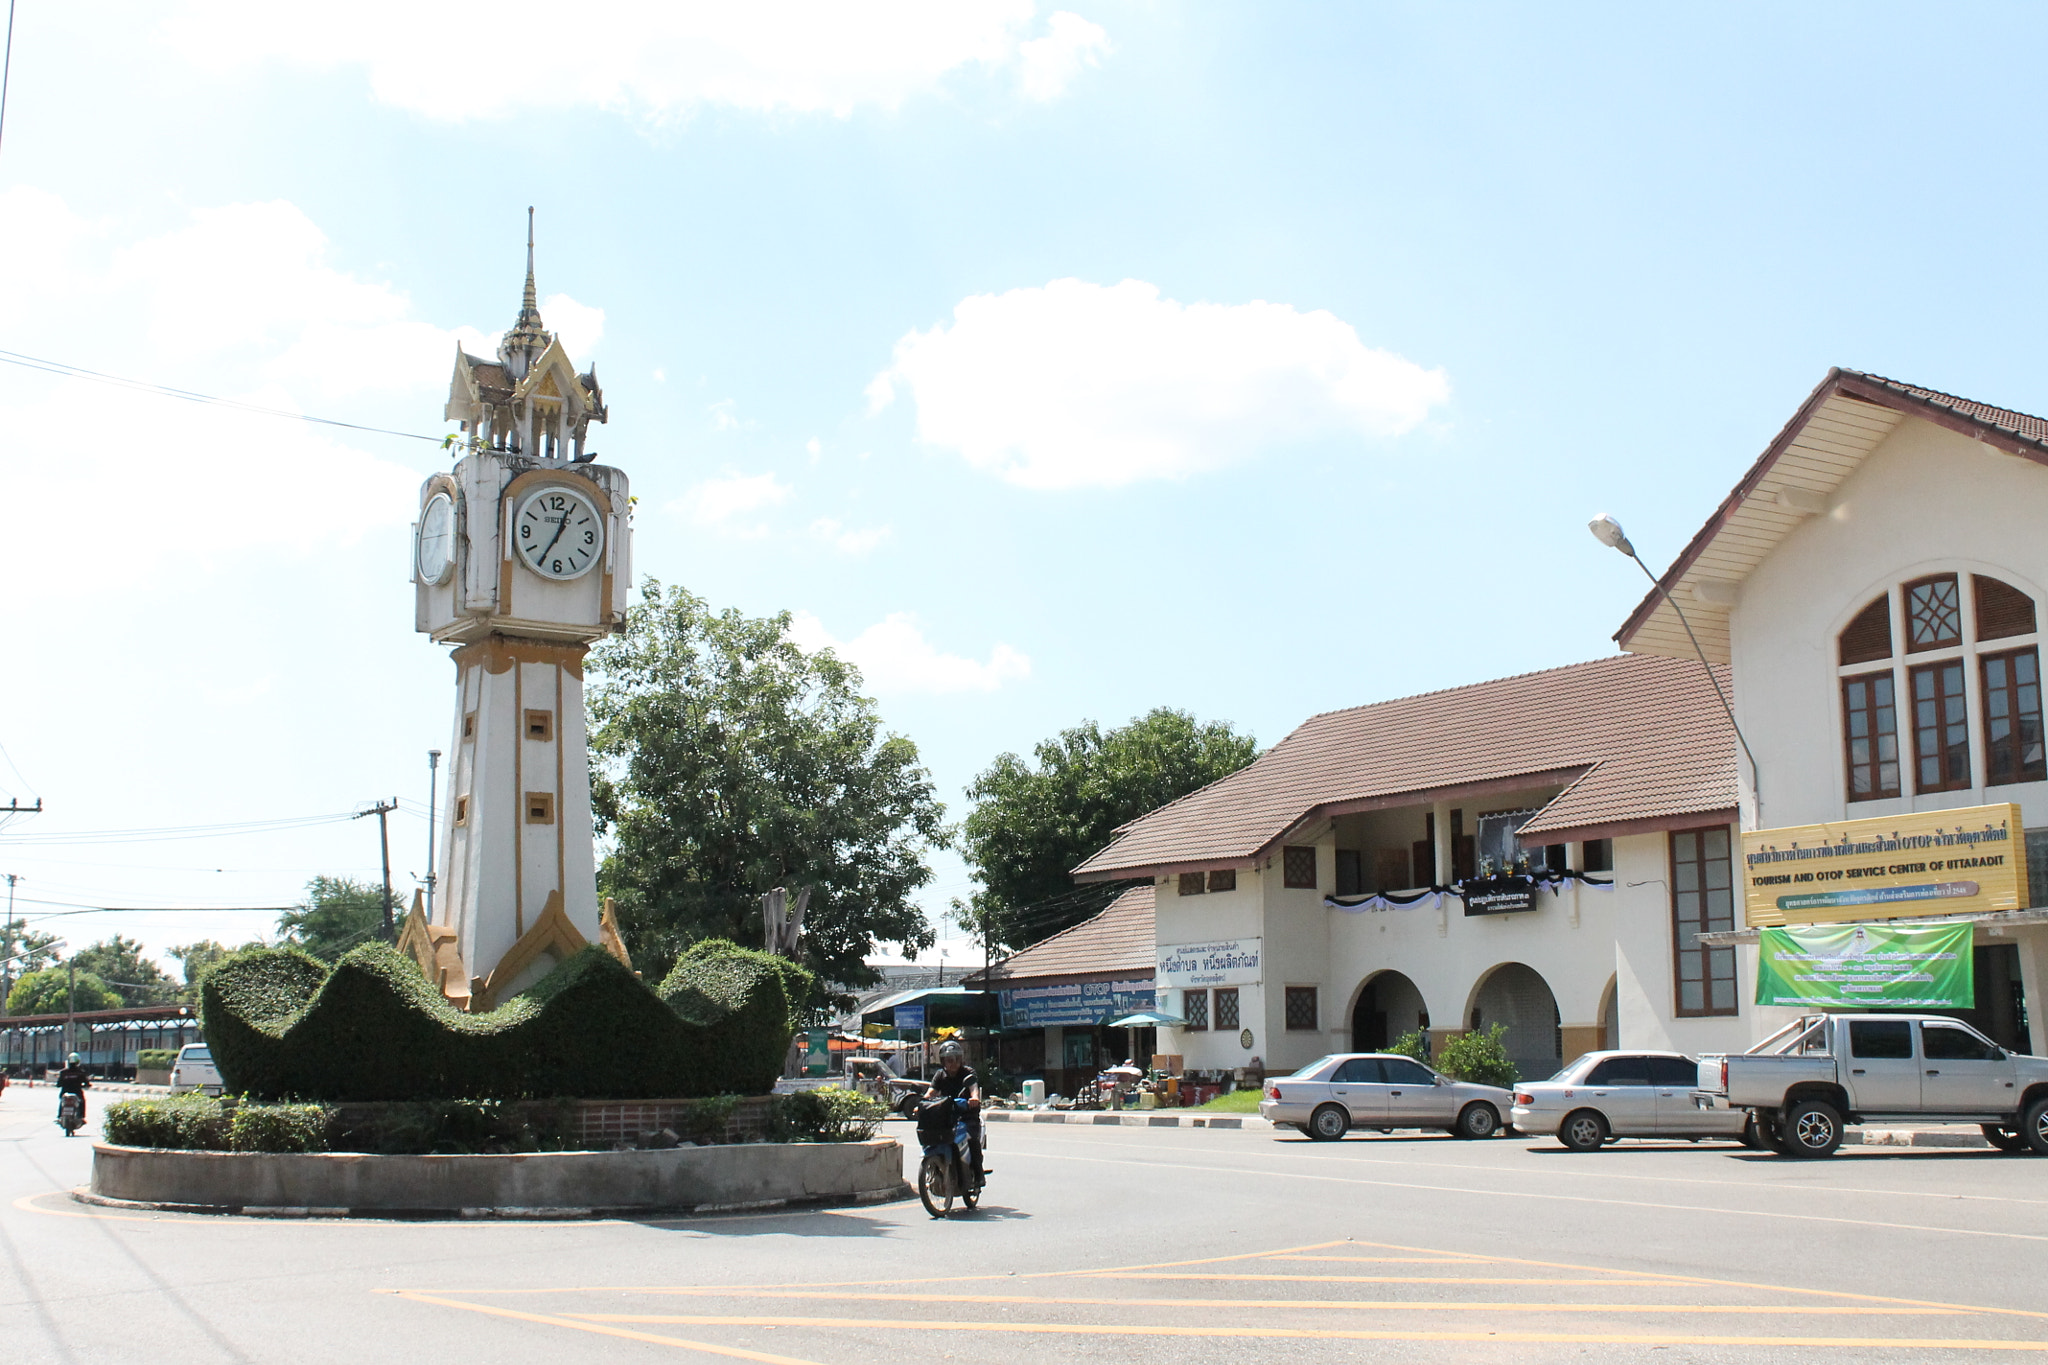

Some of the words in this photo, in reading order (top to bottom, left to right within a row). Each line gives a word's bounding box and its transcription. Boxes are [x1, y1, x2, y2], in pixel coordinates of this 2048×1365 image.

[550, 497, 565, 510] 12
[544, 516, 571, 525] SEIO
[521, 525, 531, 538] 9
[584, 531, 594, 544] 3
[553, 560, 562, 573] 6
[1902, 835, 1932, 849] OTOP
[1752, 874, 1791, 886] TOURISM
[1794, 873, 1814, 883] AND
[1816, 870, 1843, 881] OTOP
[1846, 866, 1886, 878] SERVICE
[1888, 862, 1926, 875] CENTER
[1929, 860, 1944, 871] OF
[1946, 855, 2004, 869] UTTARADIT
[1160, 954, 1197, 973] หนึ่งตำบล
[1203, 950, 1259, 971] หนึ่งผลิตภัณฑ์
[1083, 983, 1110, 996] OTOP
